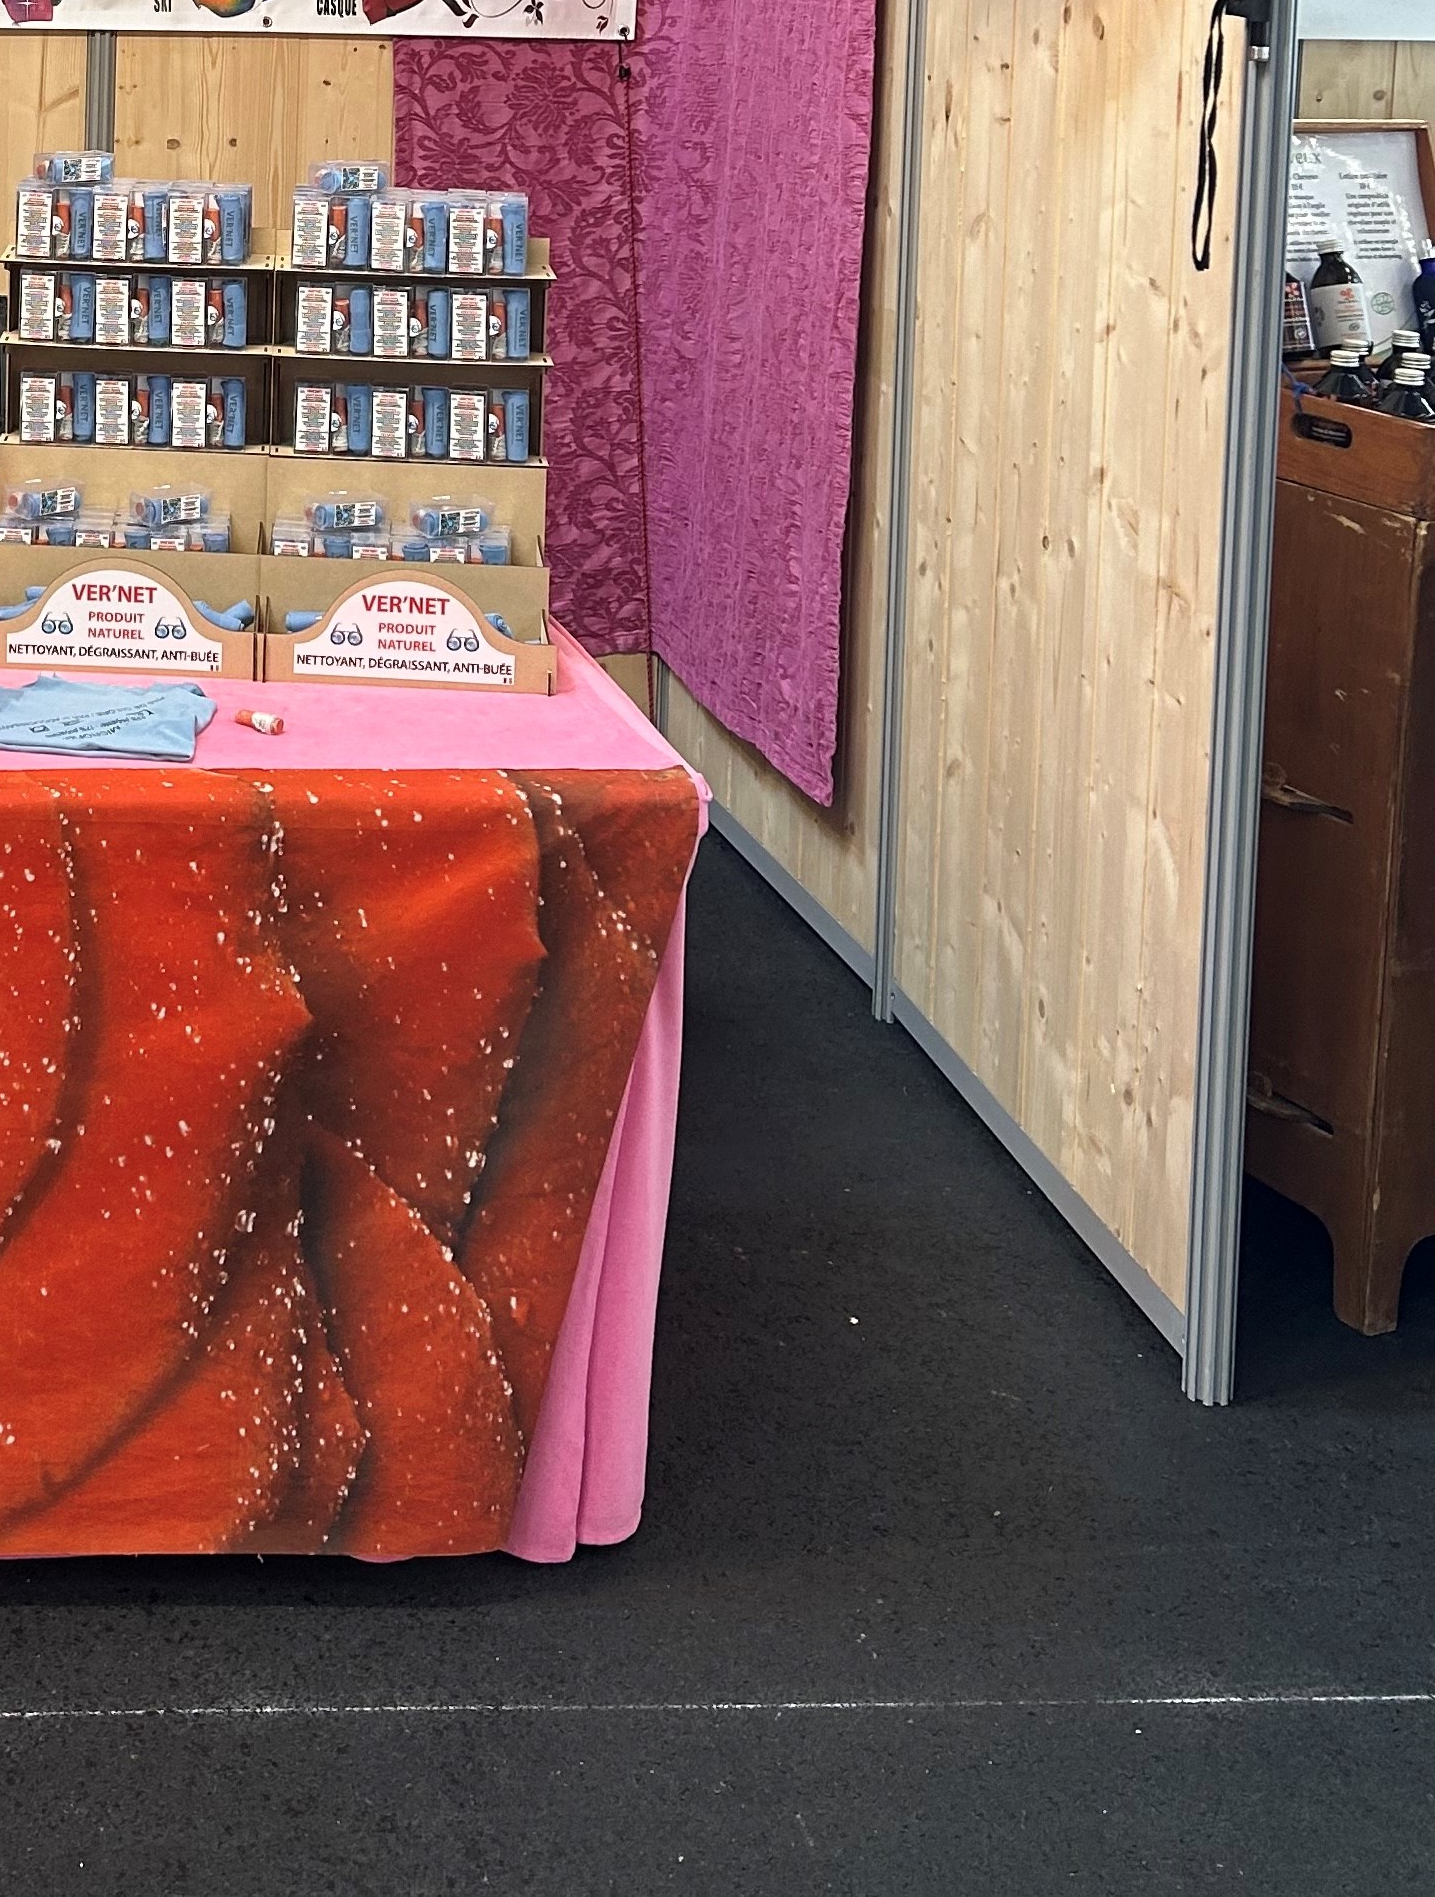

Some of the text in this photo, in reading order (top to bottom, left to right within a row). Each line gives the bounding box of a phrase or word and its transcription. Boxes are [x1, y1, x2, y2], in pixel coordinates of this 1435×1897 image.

[72, 584, 157, 604] VER'NET
[362, 594, 450, 615] VER'NET
[88, 611, 145, 624] PRODUIT
[87, 627, 145, 640] NATUREL
[378, 622, 436, 636] PRODUIT
[8, 644, 219, 663] NETTOYANT, DÉGRAISSANT, ANTI-BUÉE
[377, 639, 436, 652] NATUREL
[296, 654, 512, 676] NETTOYANT, DÉGRAISSANT, ANTI-BUÉE
